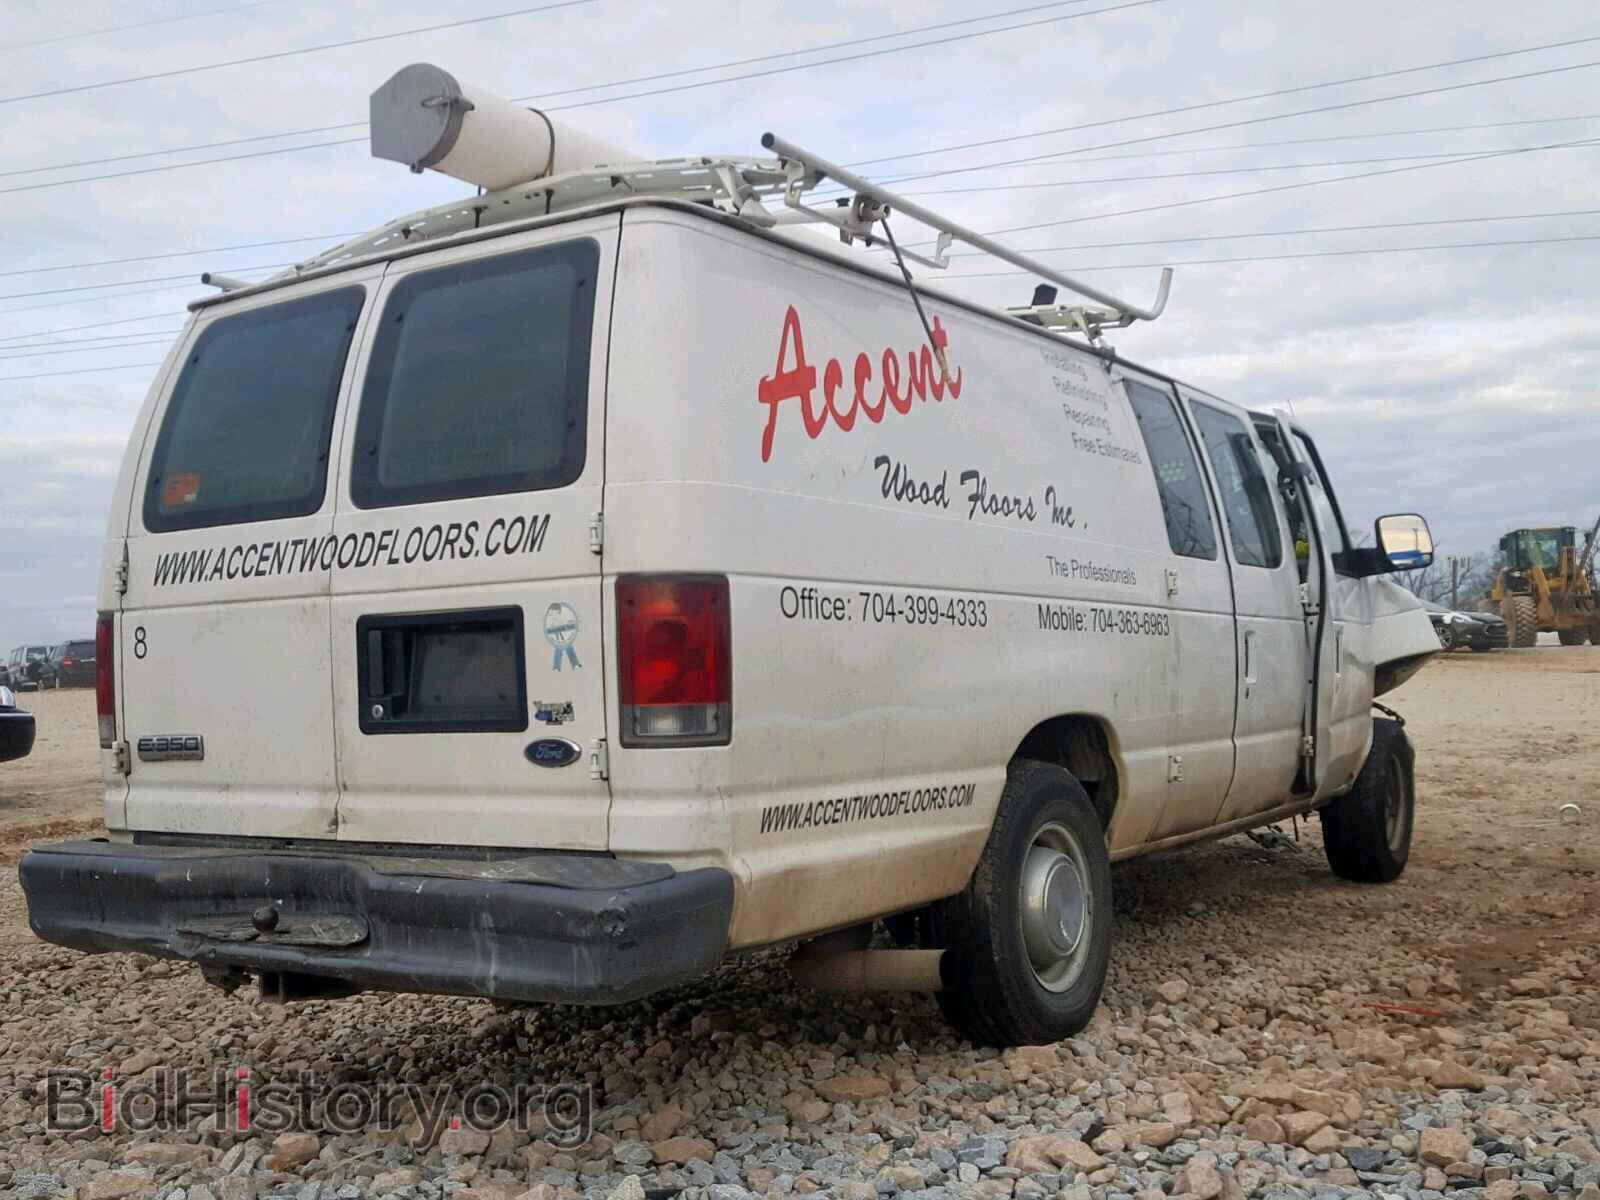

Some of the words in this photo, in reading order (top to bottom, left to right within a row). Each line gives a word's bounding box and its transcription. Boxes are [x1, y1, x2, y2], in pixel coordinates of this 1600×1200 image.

[759, 304, 962, 463] Accent
[1071, 431, 1096, 455] Free
[874, 454, 950, 509] Wood
[960, 469, 1037, 521] Floors
[153, 513, 551, 586] WWW.ACCENTWOODFLOORS.COM
[1046, 555, 1069, 578] The
[1071, 558, 1136, 586] Professionals
[780, 585, 852, 621] Office:
[859, 591, 988, 628] 704-399-4333
[1037, 603, 1088, 632] Mobile:
[1089, 607, 1170, 636] 704-363-6963
[133, 626, 149, 660] 8
[759, 783, 976, 835] WWW.ACCENTWOODFLOORS.COM
